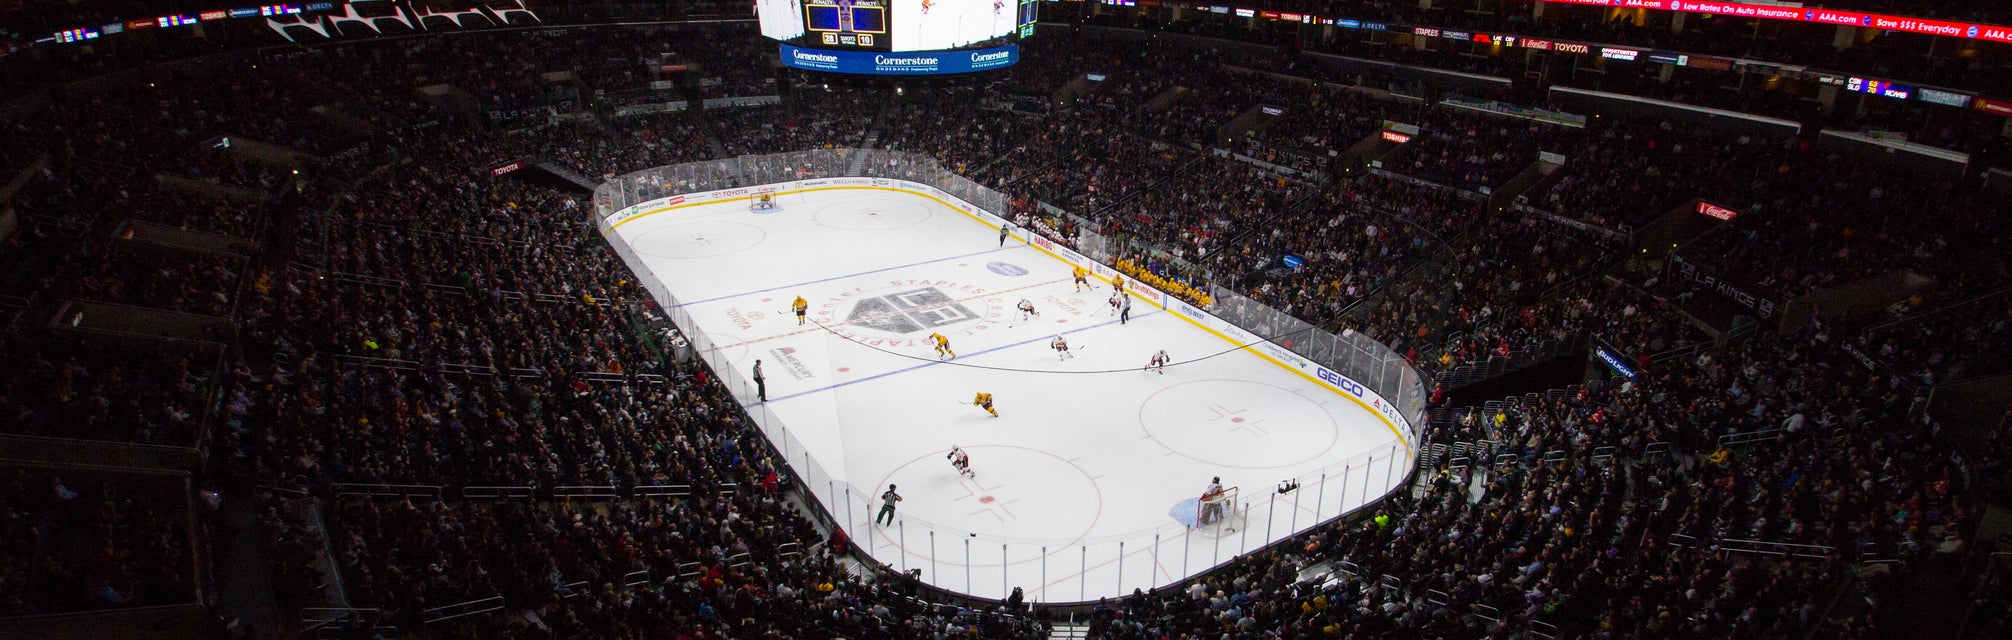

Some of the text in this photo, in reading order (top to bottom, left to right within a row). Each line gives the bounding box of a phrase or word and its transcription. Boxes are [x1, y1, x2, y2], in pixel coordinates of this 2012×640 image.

[1626, 0, 1661, 8] AAA.com
[1699, 5, 1721, 13] Rates
[1722, 6, 1735, 14] On
[1736, 7, 1755, 15] Auto
[1756, 8, 1799, 19] Insurance
[1819, 13, 1857, 24] AAA.com
[1415, 27, 1439, 37] STAPLES
[1876, 18, 1961, 36] Save $$$ Everyday
[825, 35, 835, 43] 28
[860, 36, 870, 44] 10
[1554, 42, 1588, 54] TOYOTA
[793, 49, 838, 63] Cornerstone
[875, 54, 939, 66] Cornerstone
[971, 51, 1009, 63] Cornerstone
[1819, 76, 1844, 86] verion
[495, 163, 519, 175] TOYOTA
[723, 189, 749, 197] TOYOTA
[1034, 236, 1053, 251] HARIBO
[889, 278, 987, 295] STAPLES
[1134, 280, 1159, 300] DraftKings
[1317, 367, 1363, 398] GEICO
[1382, 403, 1405, 431] DELTA
